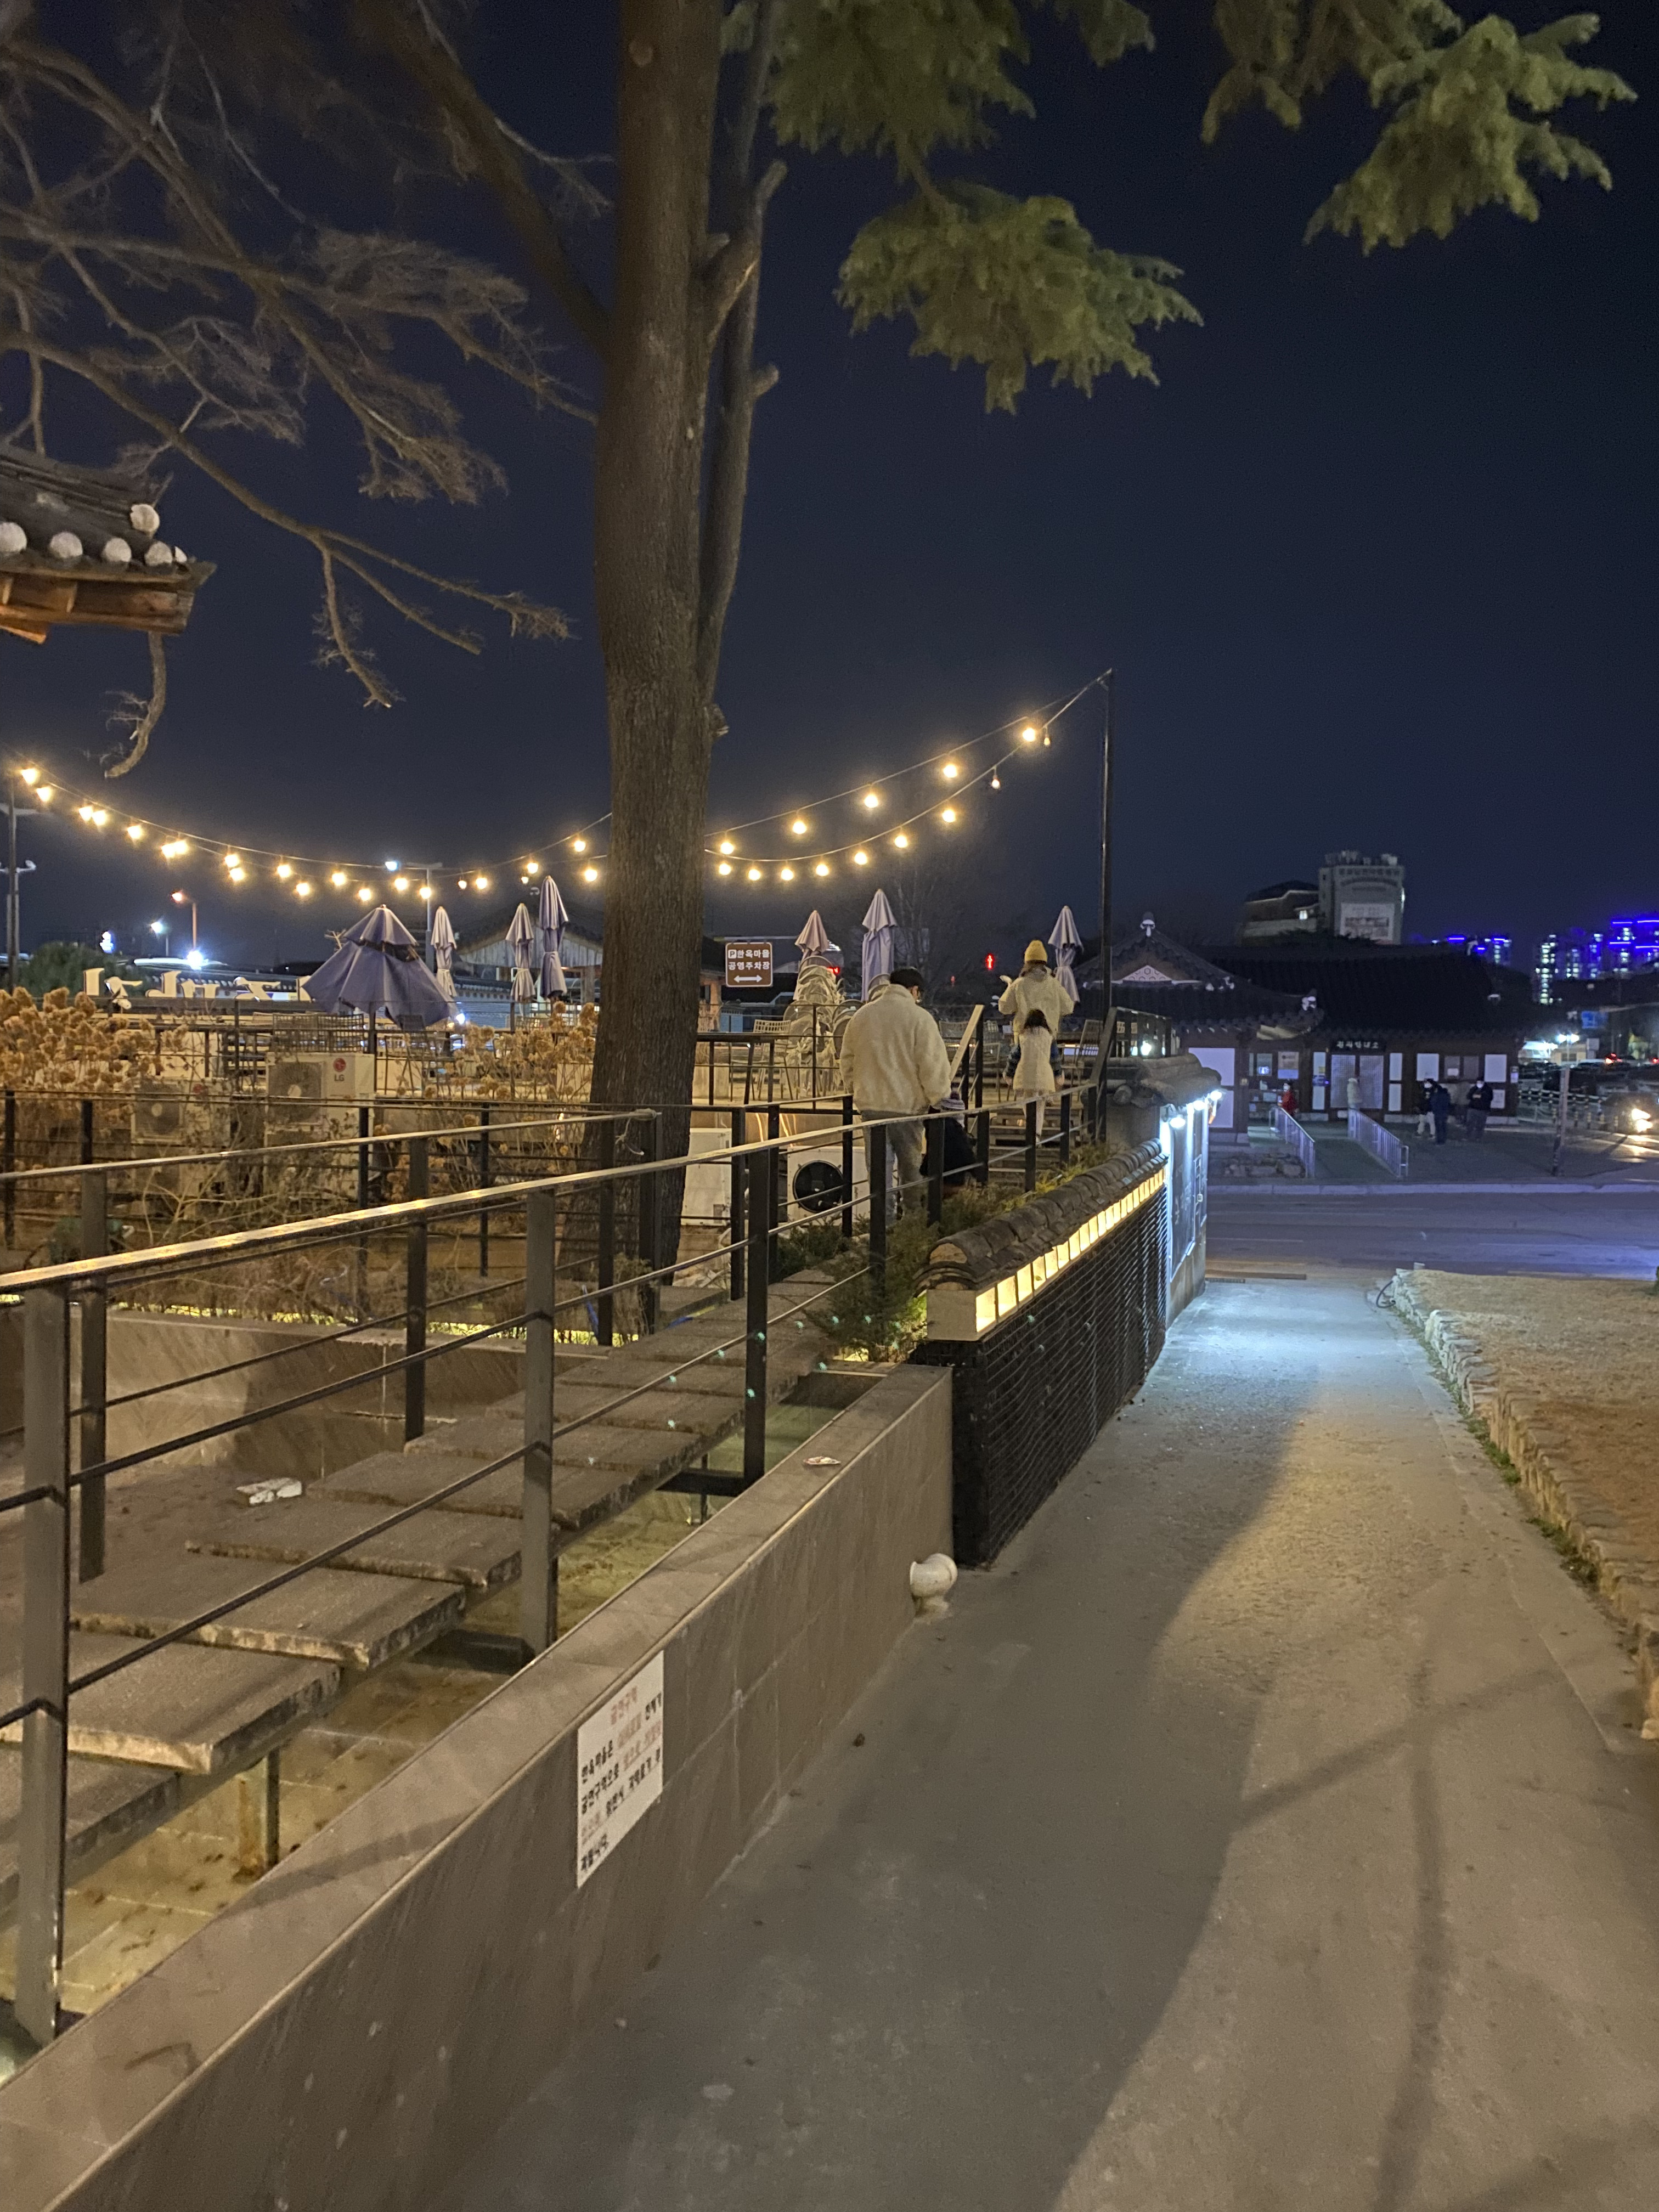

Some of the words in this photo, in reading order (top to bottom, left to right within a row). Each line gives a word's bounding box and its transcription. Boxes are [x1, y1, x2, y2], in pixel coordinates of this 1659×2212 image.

[729, 961, 770, 970] 공영주차장
[737, 950, 770, 958] 한옥마을
[611, 1686, 637, 1726] 금연구역
[582, 1740, 613, 1784] 한옥마을은
[629, 1757, 651, 1789] 과태료가
[582, 1762, 619, 1815] 금연구역으로
